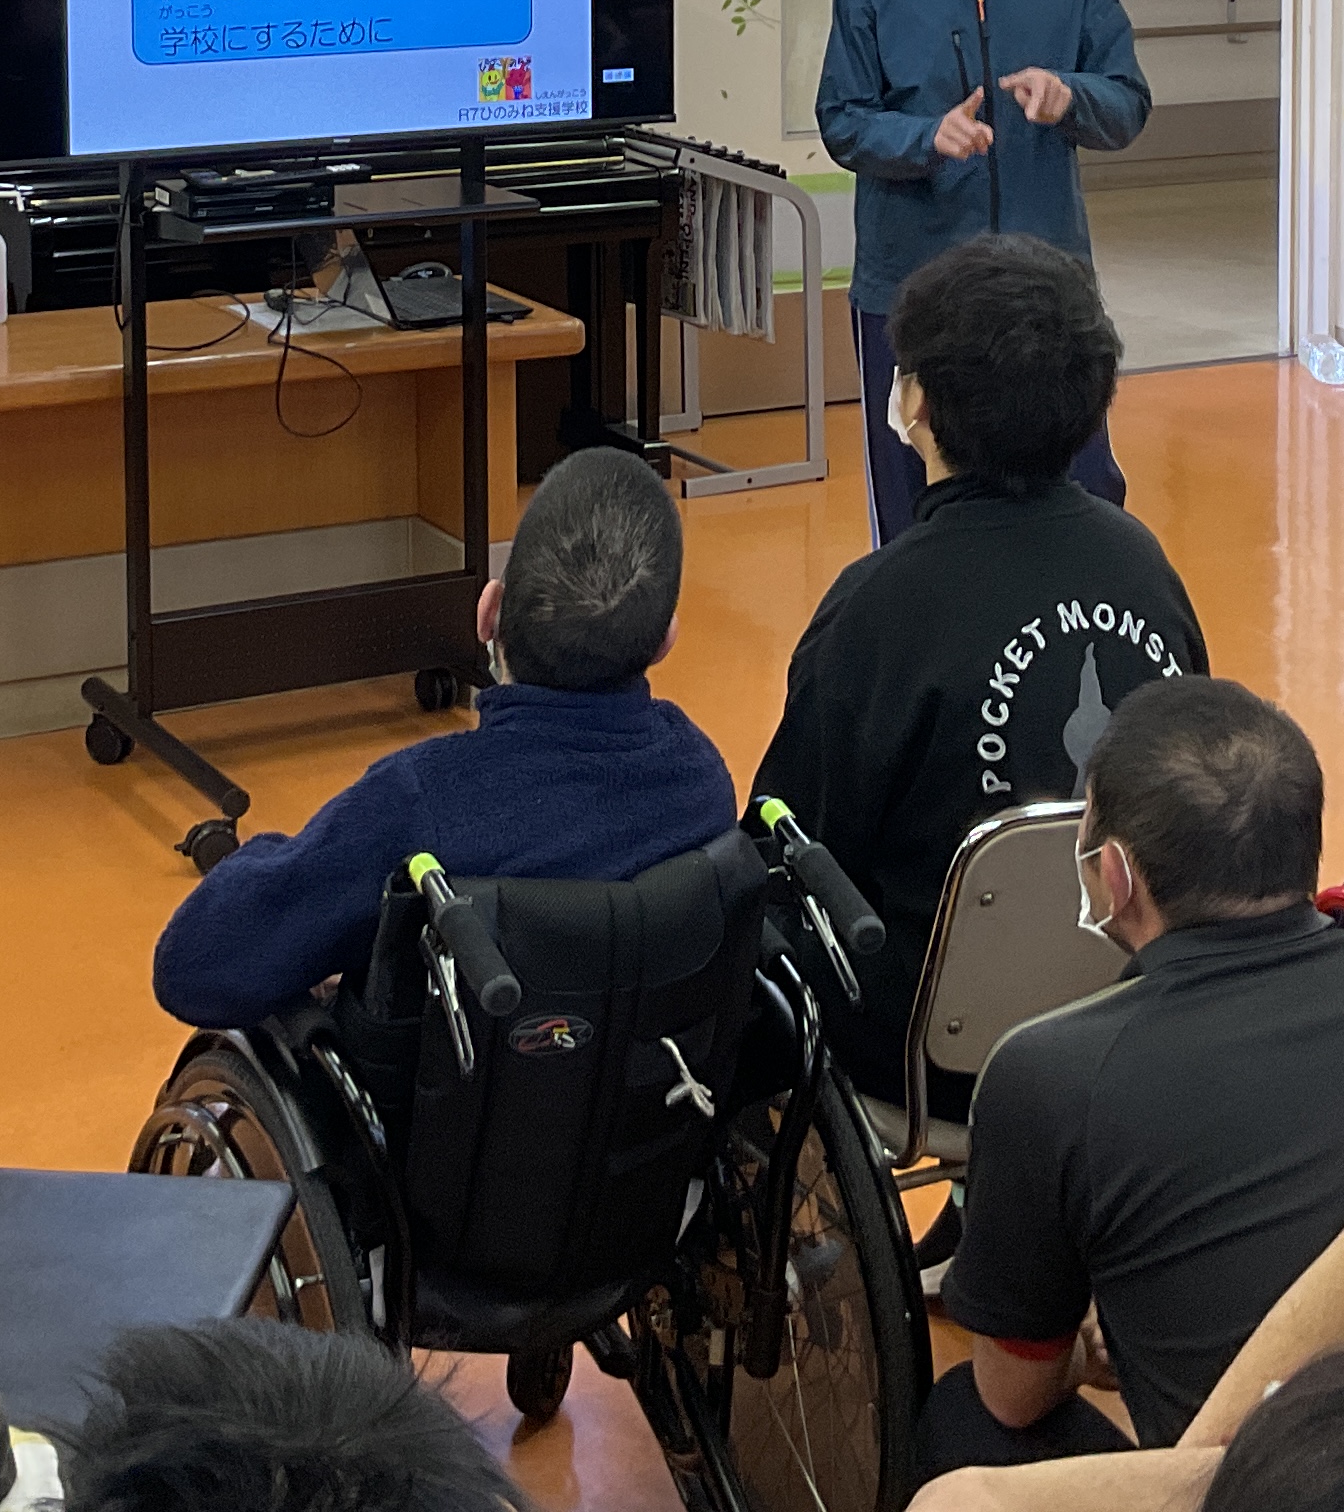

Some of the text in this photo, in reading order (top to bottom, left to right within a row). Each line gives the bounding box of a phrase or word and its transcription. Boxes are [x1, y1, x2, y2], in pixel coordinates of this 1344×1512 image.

[158, 4, 214, 19] がっこう
[159, 16, 394, 57] 学校にするために
[458, 100, 589, 123] R7ひのみね支援学校
[977, 617, 1047, 795] POCKET
